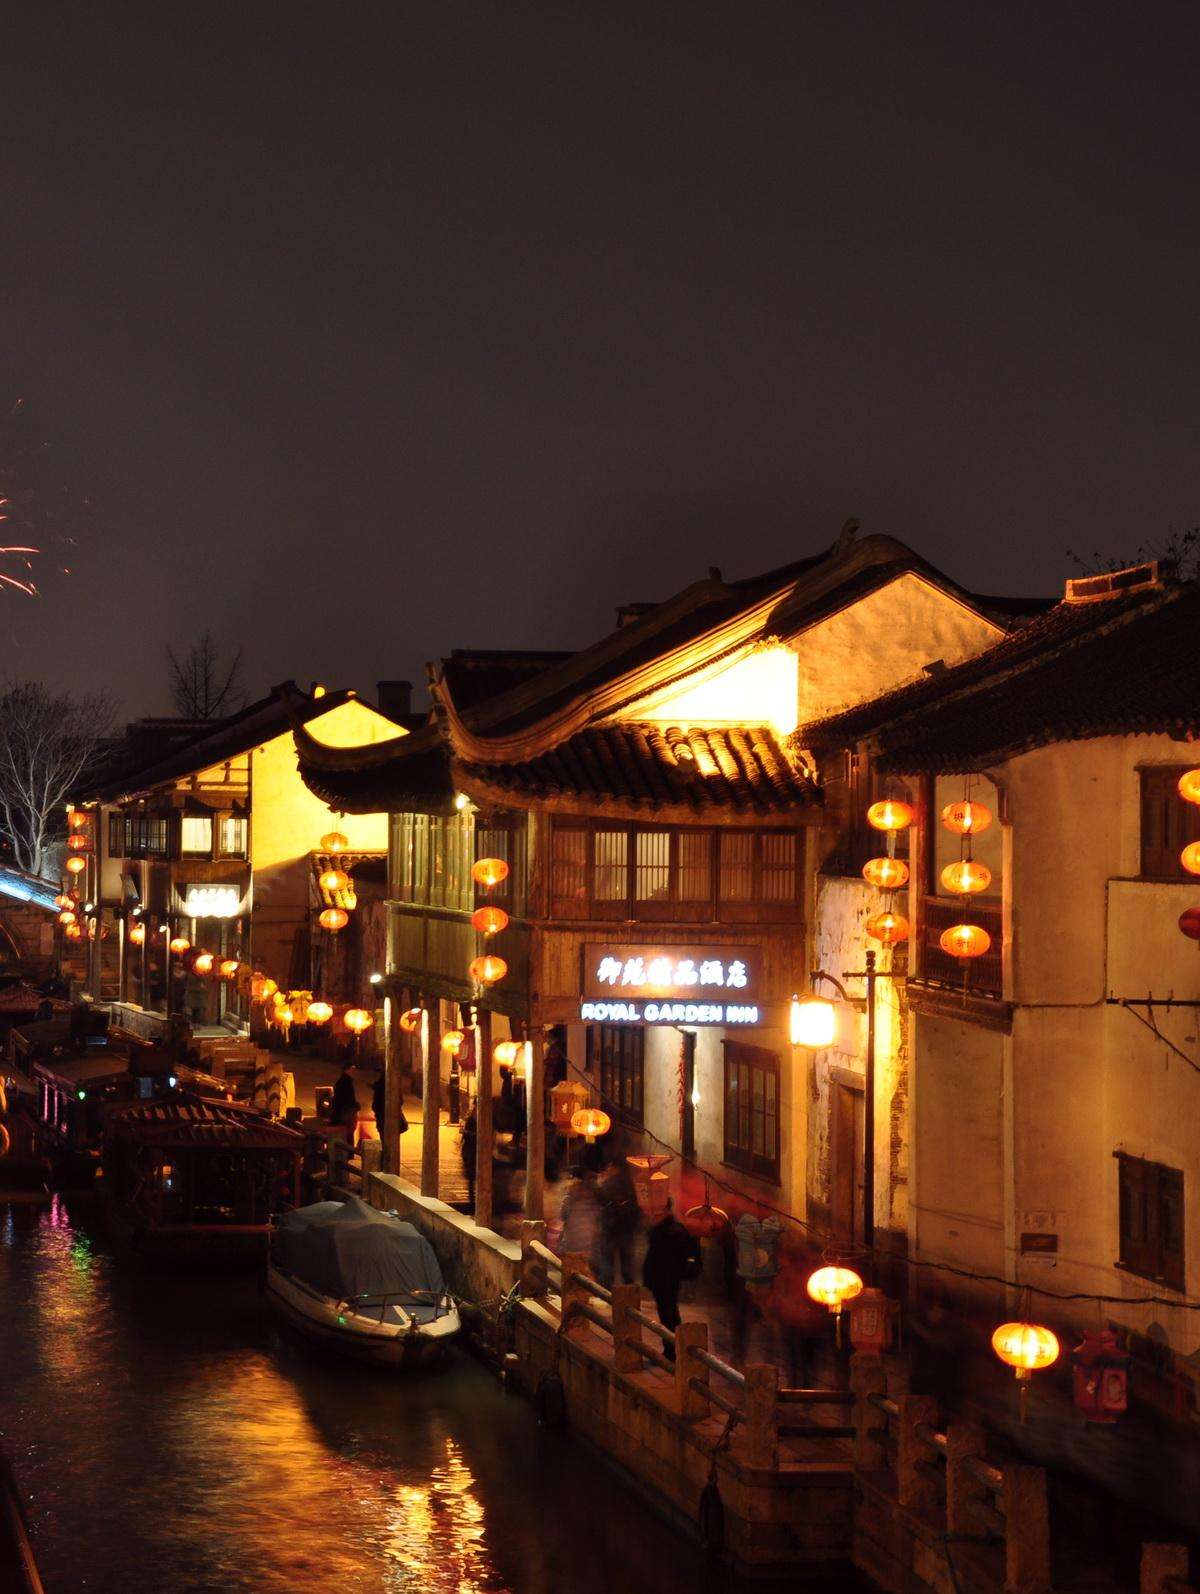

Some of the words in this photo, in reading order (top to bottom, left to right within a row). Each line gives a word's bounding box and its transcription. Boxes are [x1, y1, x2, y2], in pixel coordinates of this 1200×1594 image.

[581, 1003, 640, 1021] ROYAL
[644, 1003, 722, 1022] GARDEN
[726, 1005, 758, 1023] INN
